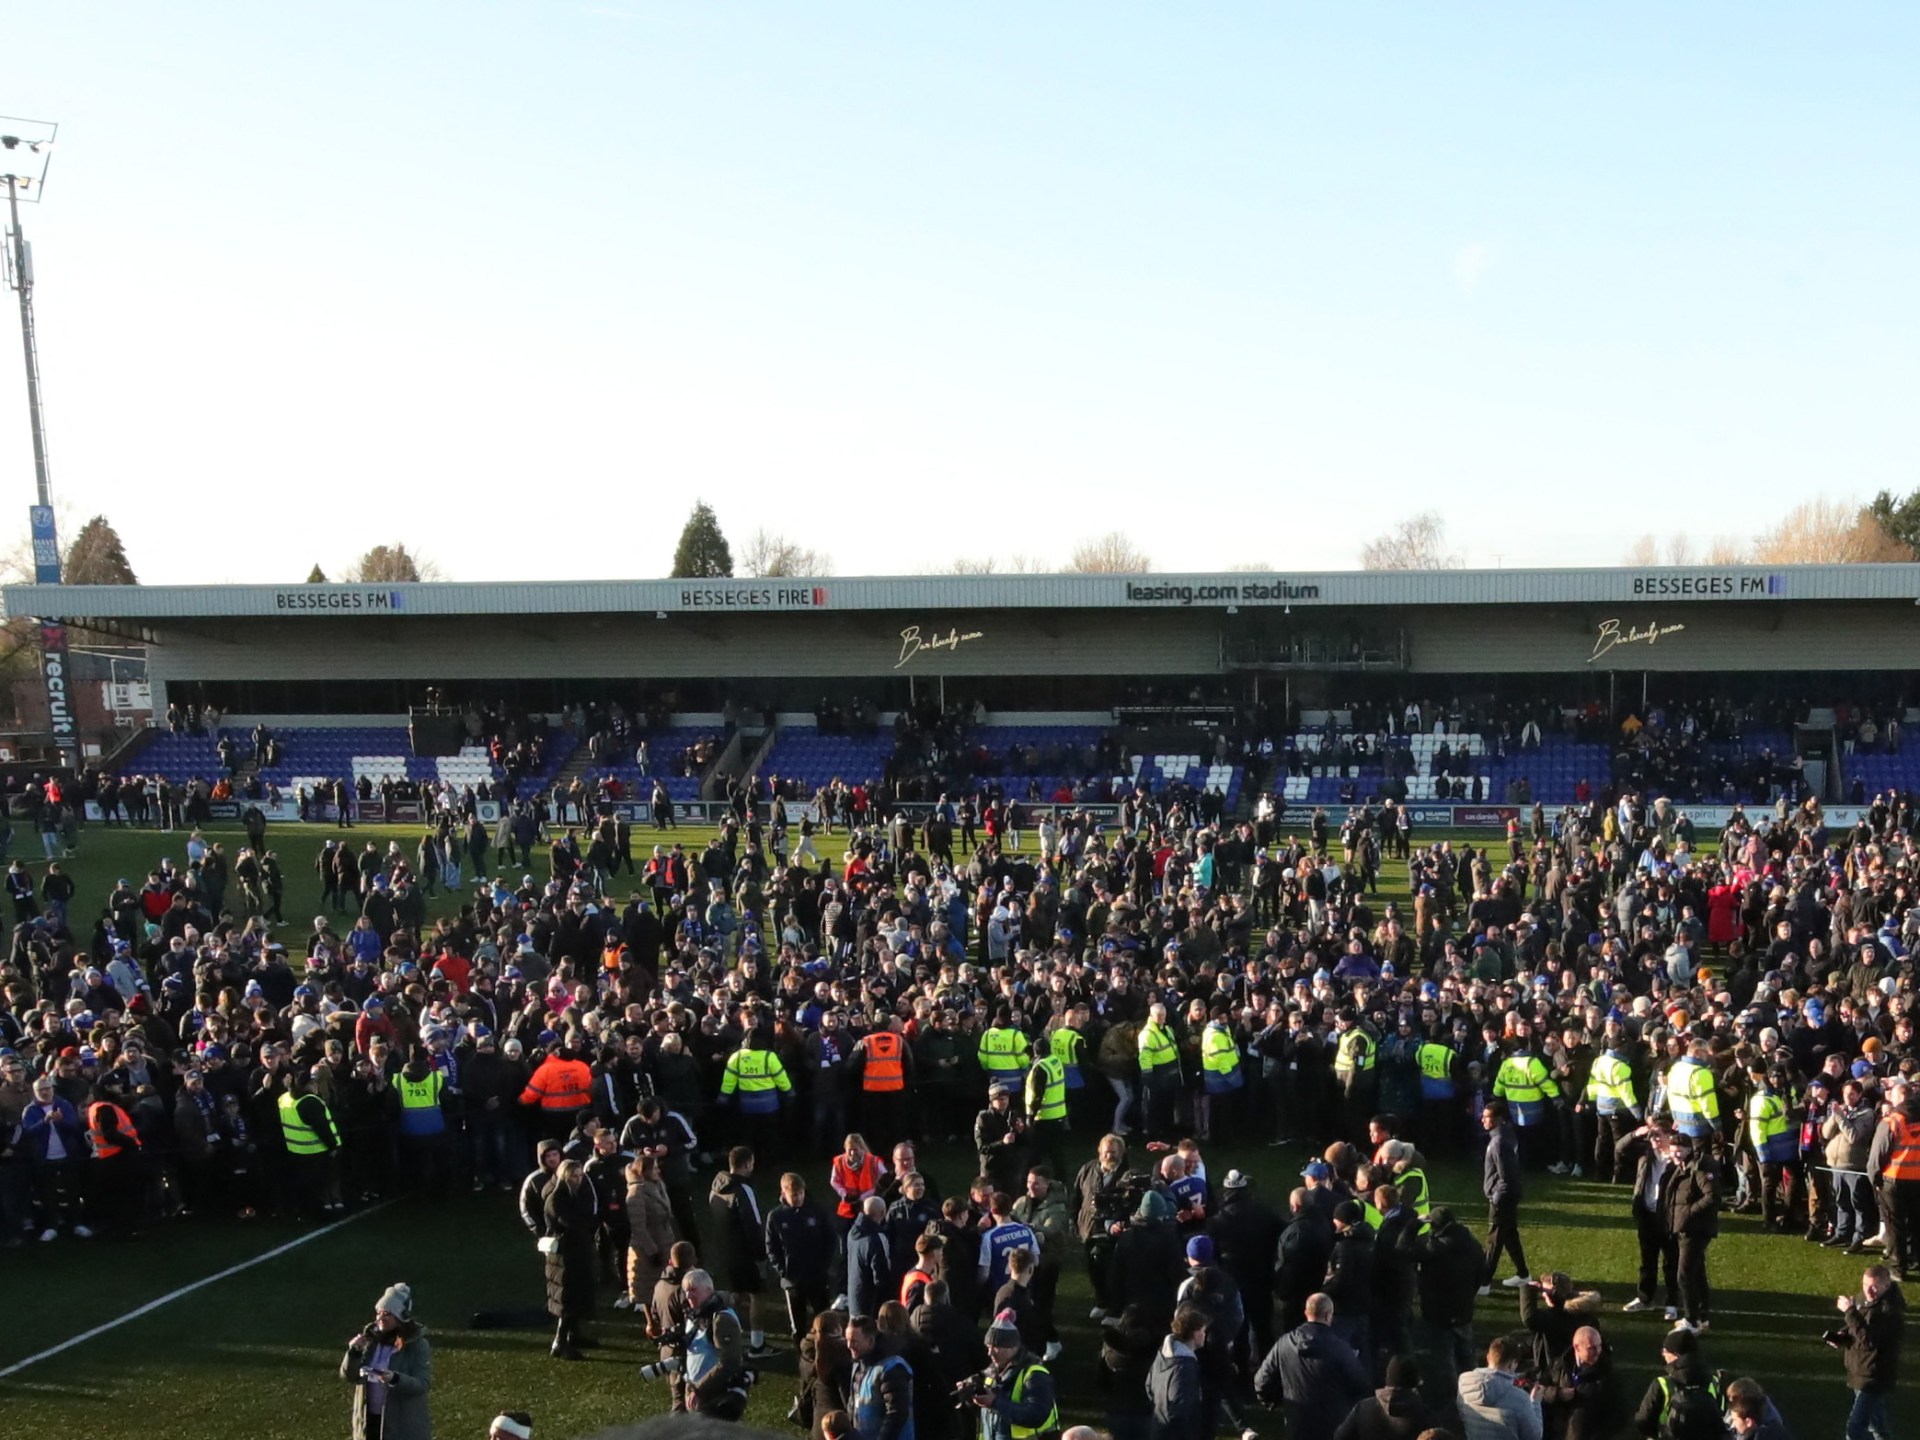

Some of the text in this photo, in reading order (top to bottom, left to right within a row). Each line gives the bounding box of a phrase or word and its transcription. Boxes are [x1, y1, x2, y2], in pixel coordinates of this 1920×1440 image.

[1127, 580, 1319, 604] leasing.com stadium
[1633, 576, 1765, 594] BESSEGES FM
[276, 592, 388, 609] BESSEGES FM
[682, 588, 810, 606] BESSEGES FIRE
[45, 652, 74, 733] recruit
[408, 1089, 427, 1097] 793
